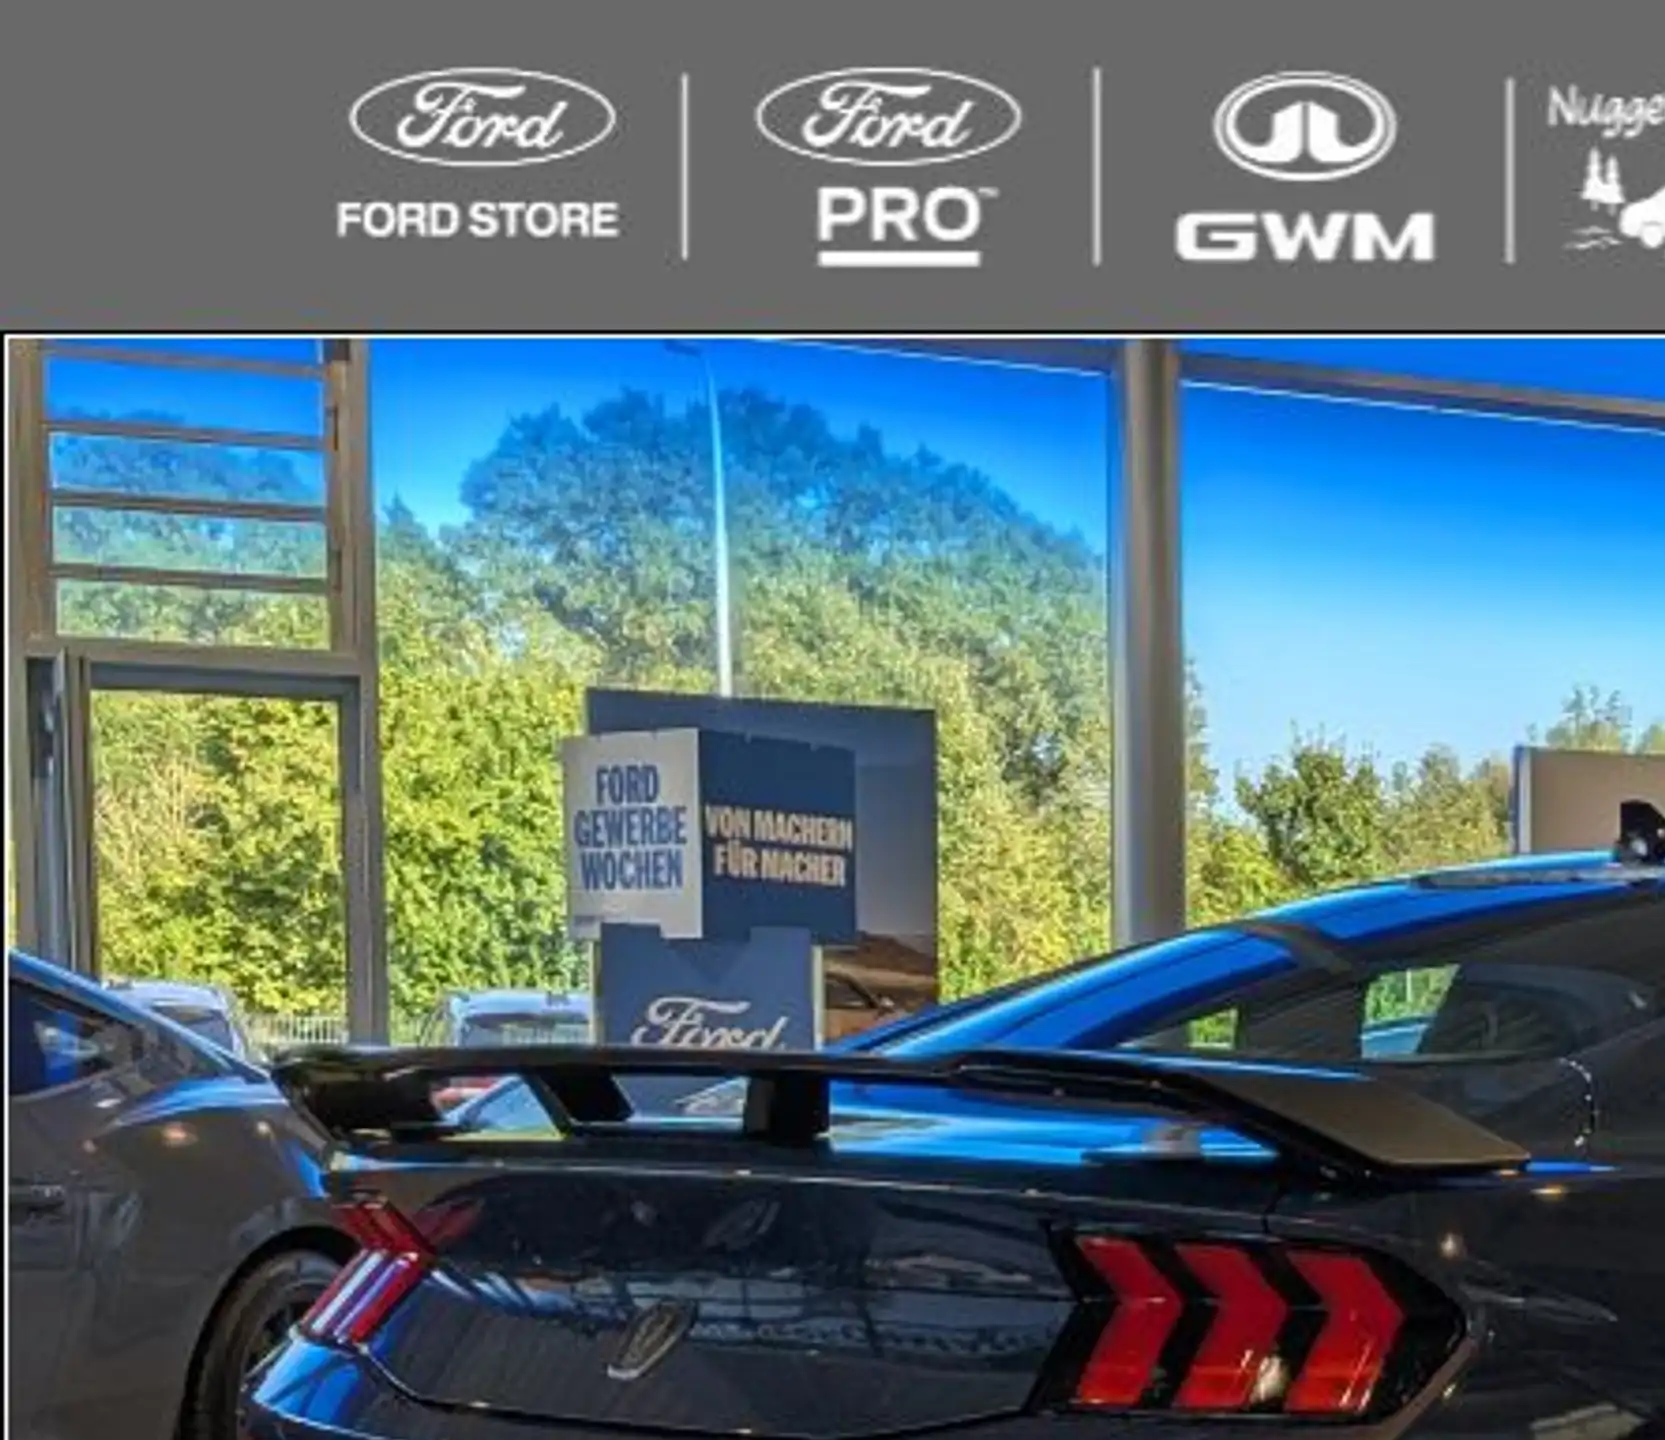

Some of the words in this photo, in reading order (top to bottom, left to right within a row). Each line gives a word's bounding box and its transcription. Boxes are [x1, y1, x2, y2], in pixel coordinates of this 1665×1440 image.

[595, 764, 660, 805] FORD
[574, 806, 688, 849] GEWERBE
[705, 805, 751, 838] VON
[754, 809, 853, 852] MACHERN
[581, 848, 685, 891] WOCHEN
[714, 839, 758, 878] FÜR
[761, 849, 846, 887] MACHER
